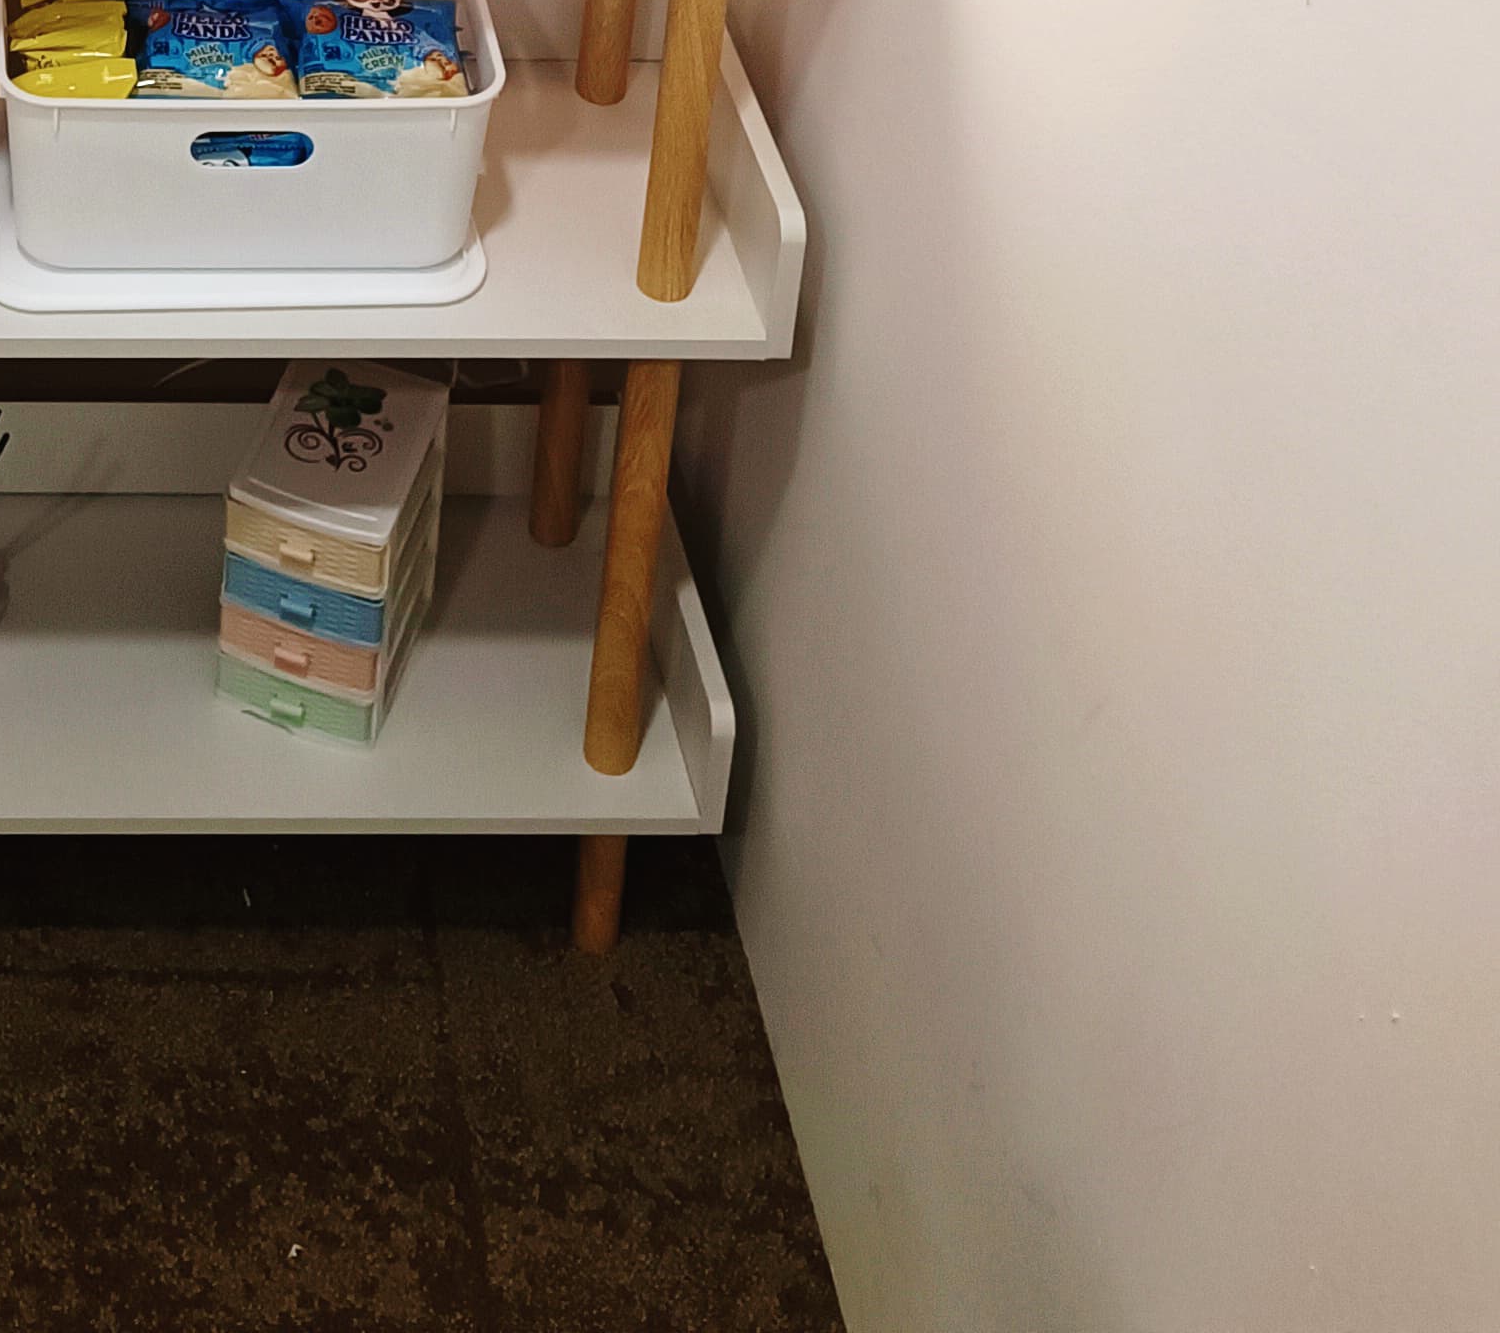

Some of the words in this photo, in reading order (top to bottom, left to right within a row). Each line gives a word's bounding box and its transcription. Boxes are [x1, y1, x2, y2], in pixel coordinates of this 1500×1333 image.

[343, 14, 412, 32] HELLO
[175, 23, 251, 40] PANDA
[343, 29, 419, 45] PANDA
[185, 43, 219, 59] MILK
[357, 46, 392, 63] MILK
[192, 53, 234, 68] CREAM
[364, 56, 406, 71] CREAM
